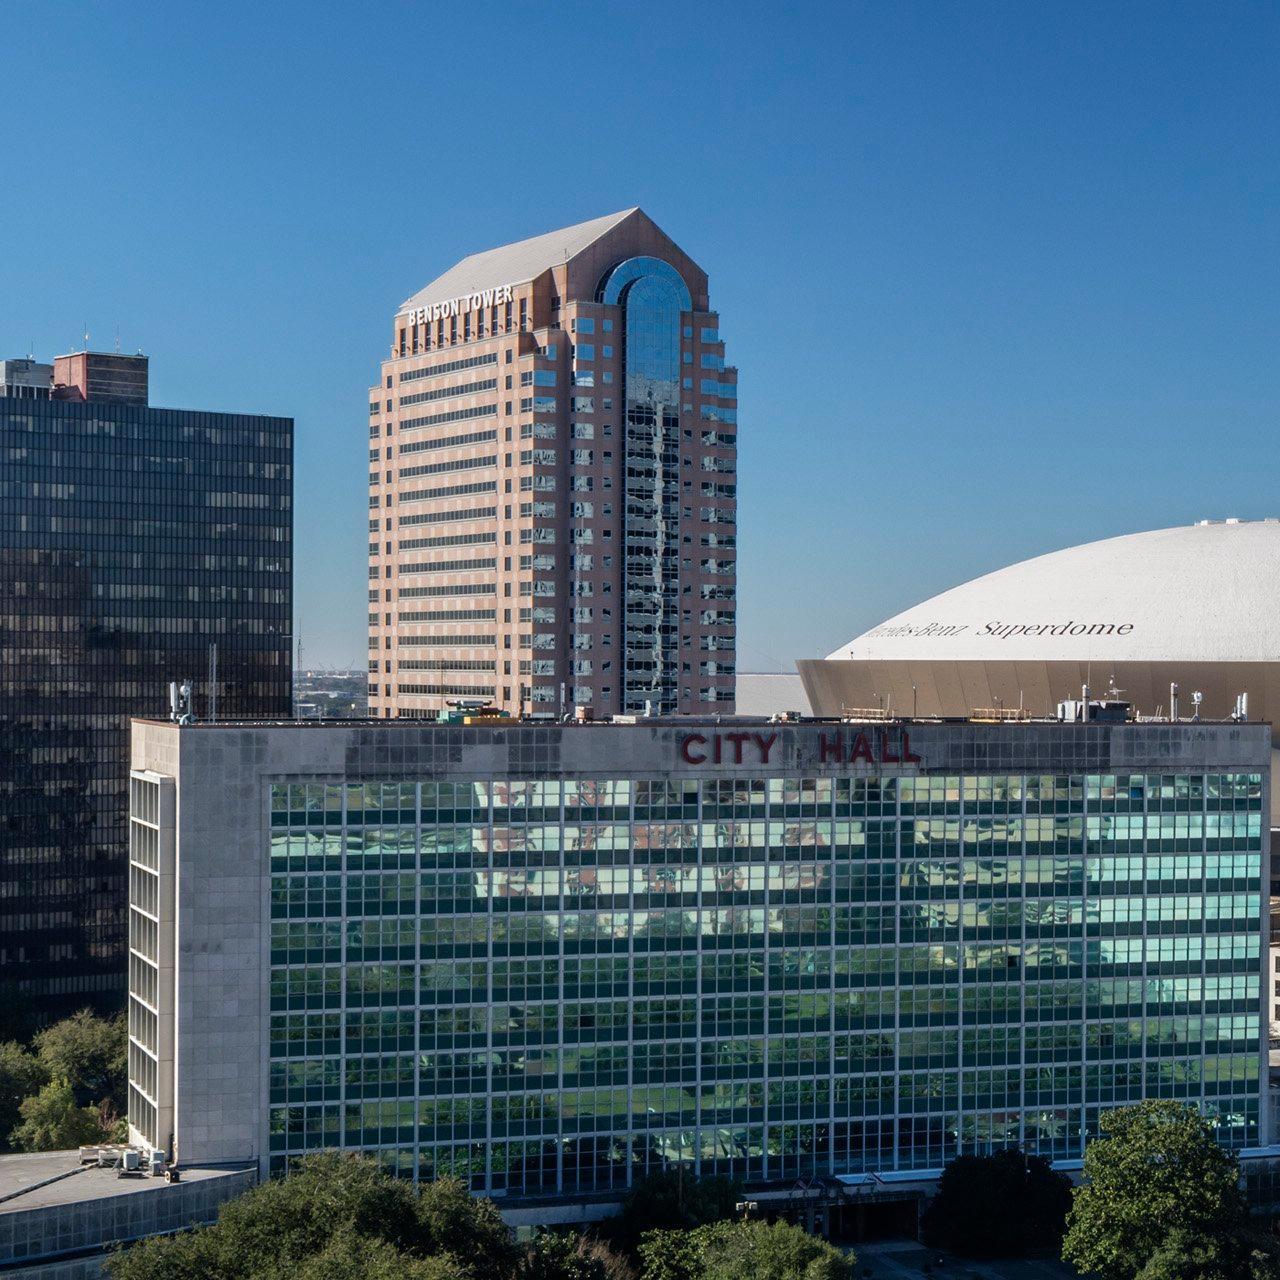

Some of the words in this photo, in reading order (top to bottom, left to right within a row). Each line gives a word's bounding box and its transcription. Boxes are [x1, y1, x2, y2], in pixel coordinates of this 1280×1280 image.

[408, 299, 460, 326] BENSON
[463, 285, 513, 313] TOWER
[975, 619, 1134, 639] Superdome
[681, 733, 778, 765] CITY
[819, 732, 922, 763] HALL
